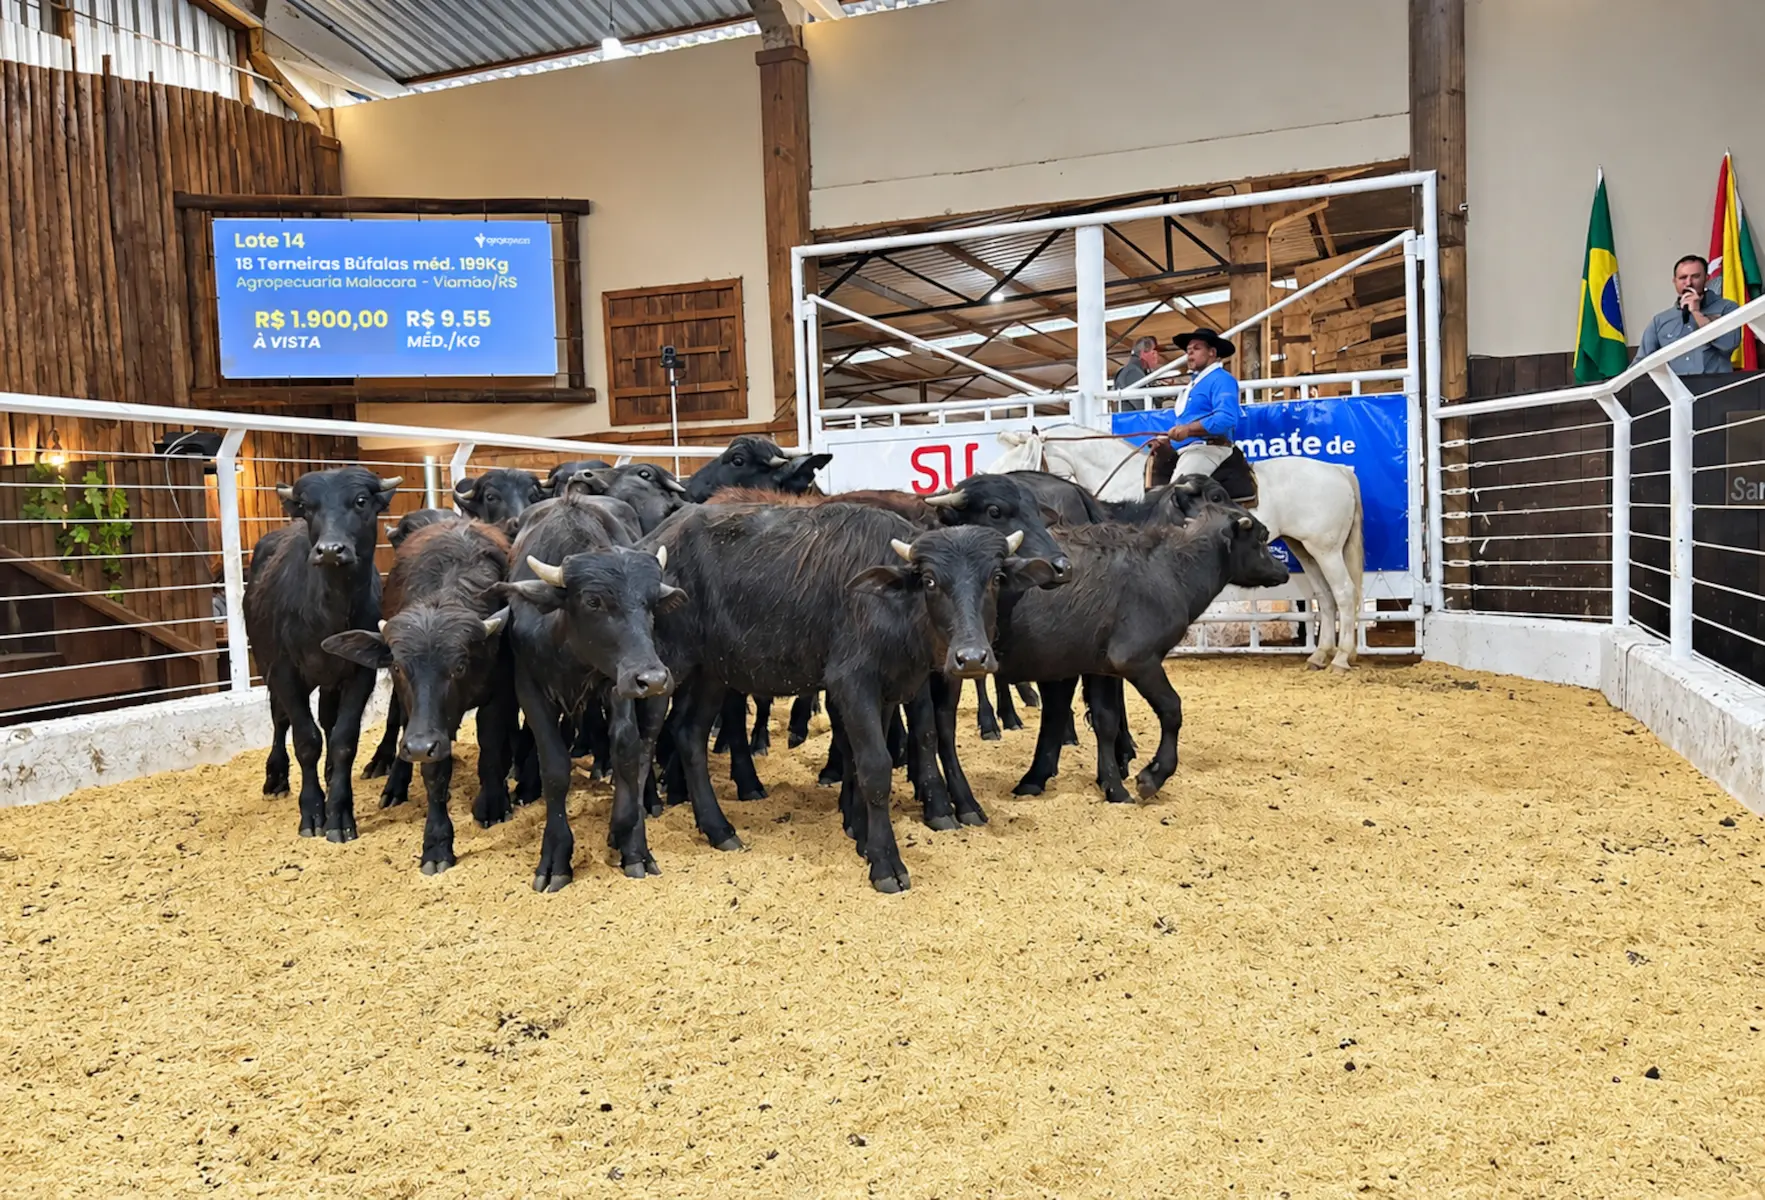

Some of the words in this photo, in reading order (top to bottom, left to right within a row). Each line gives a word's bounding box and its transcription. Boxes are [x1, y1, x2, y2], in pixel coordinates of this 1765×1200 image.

[234, 232, 279, 248] Lote
[282, 232, 305, 249] 14
[235, 257, 253, 270] 18
[257, 256, 340, 271] Terneiras
[413, 257, 455, 271] méd.
[459, 257, 509, 274] 199Kg
[255, 309, 285, 331] R$
[290, 309, 388, 331] 1.900,00
[406, 309, 435, 329] R$
[440, 309, 491, 328] 9.55
[253, 332, 267, 349] À
[270, 335, 321, 349] VISTA
[407, 331, 481, 351] MÉD./KG
[1326, 435, 1356, 455] de
